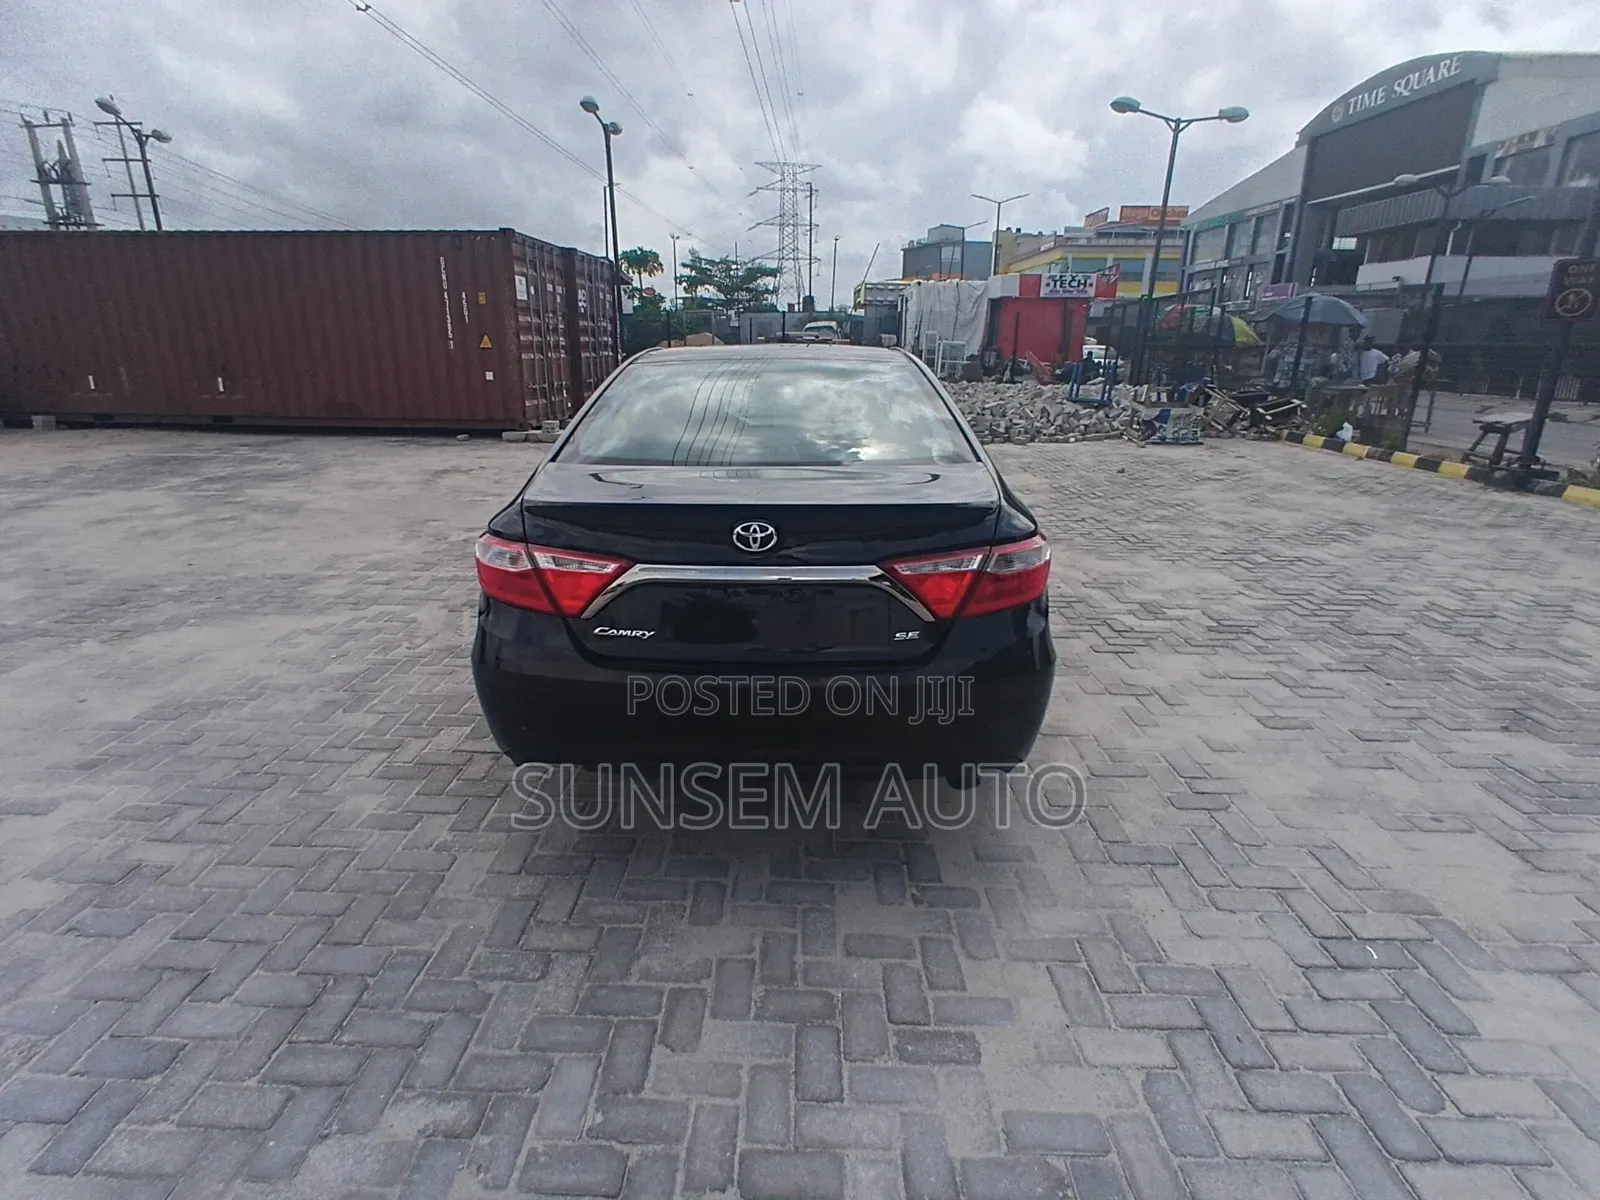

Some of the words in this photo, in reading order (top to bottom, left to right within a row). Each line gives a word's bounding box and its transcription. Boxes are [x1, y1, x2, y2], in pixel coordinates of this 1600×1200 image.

[1347, 85, 1387, 115] TIME
[1391, 54, 1462, 98] SQUARE
[1051, 278, 1088, 289] TECH
[593, 626, 656, 640] CAMRY
[893, 630, 921, 641] SE
